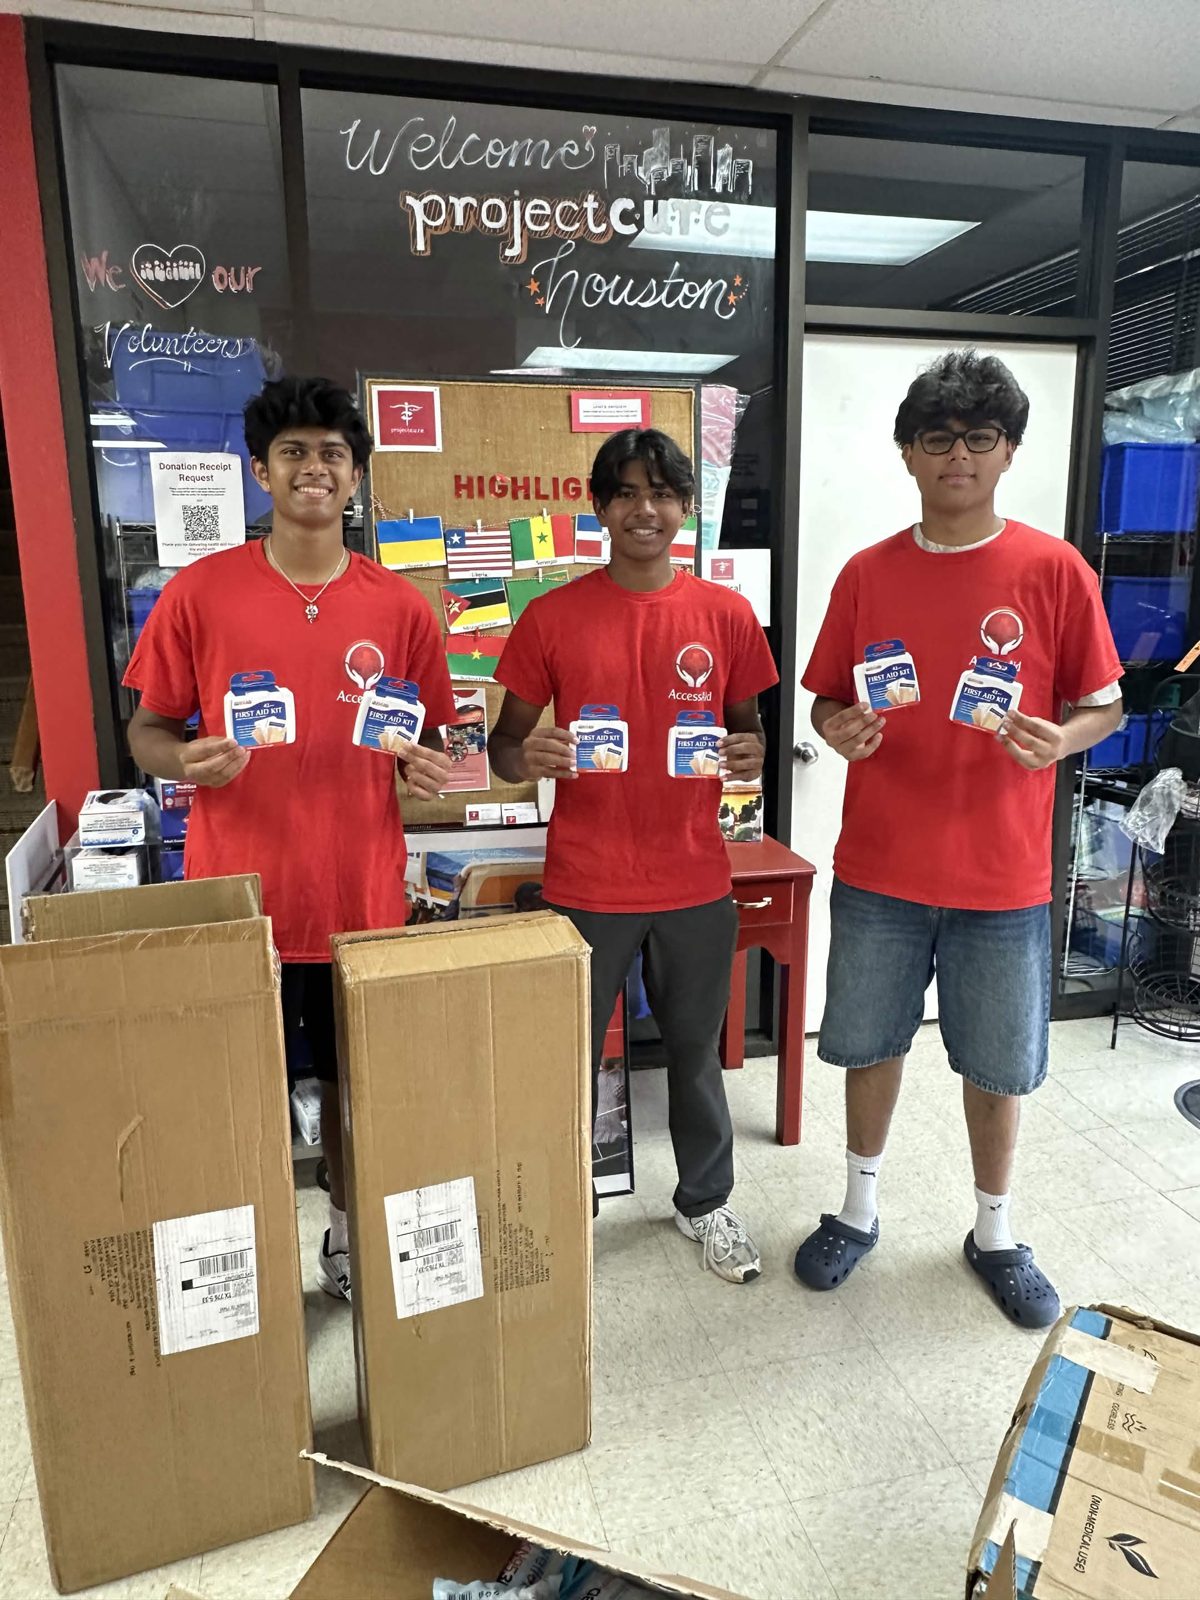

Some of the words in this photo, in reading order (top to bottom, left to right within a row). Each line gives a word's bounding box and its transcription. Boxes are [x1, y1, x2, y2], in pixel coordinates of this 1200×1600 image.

[340, 116, 595, 176] Welcome
[81, 251, 126, 292] We
[212, 265, 262, 294] our
[531, 240, 736, 349] houston
[94, 321, 251, 369] Volunteers
[159, 462, 198, 471] Donation
[200, 462, 232, 472] Receipt
[179, 474, 214, 483] Request
[867, 674, 885, 683] FIRST
[886, 671, 899, 679] AID
[900, 668, 911, 676] KIT
[668, 688, 713, 702] AccessAid
[963, 686, 982, 697] FIRST
[982, 692, 996, 701] AID
[996, 696, 1009, 704] KIT
[235, 710, 255, 719] FIRST
[255, 708, 269, 716] AID
[270, 706, 283, 714] KIT
[369, 710, 388, 721] FIRST
[388, 715, 402, 724] AID
[402, 718, 415, 727] KIT
[1079, 1494, 1103, 1551] (NON-MEDICAL
[1073, 1550, 1089, 1574] USE)
